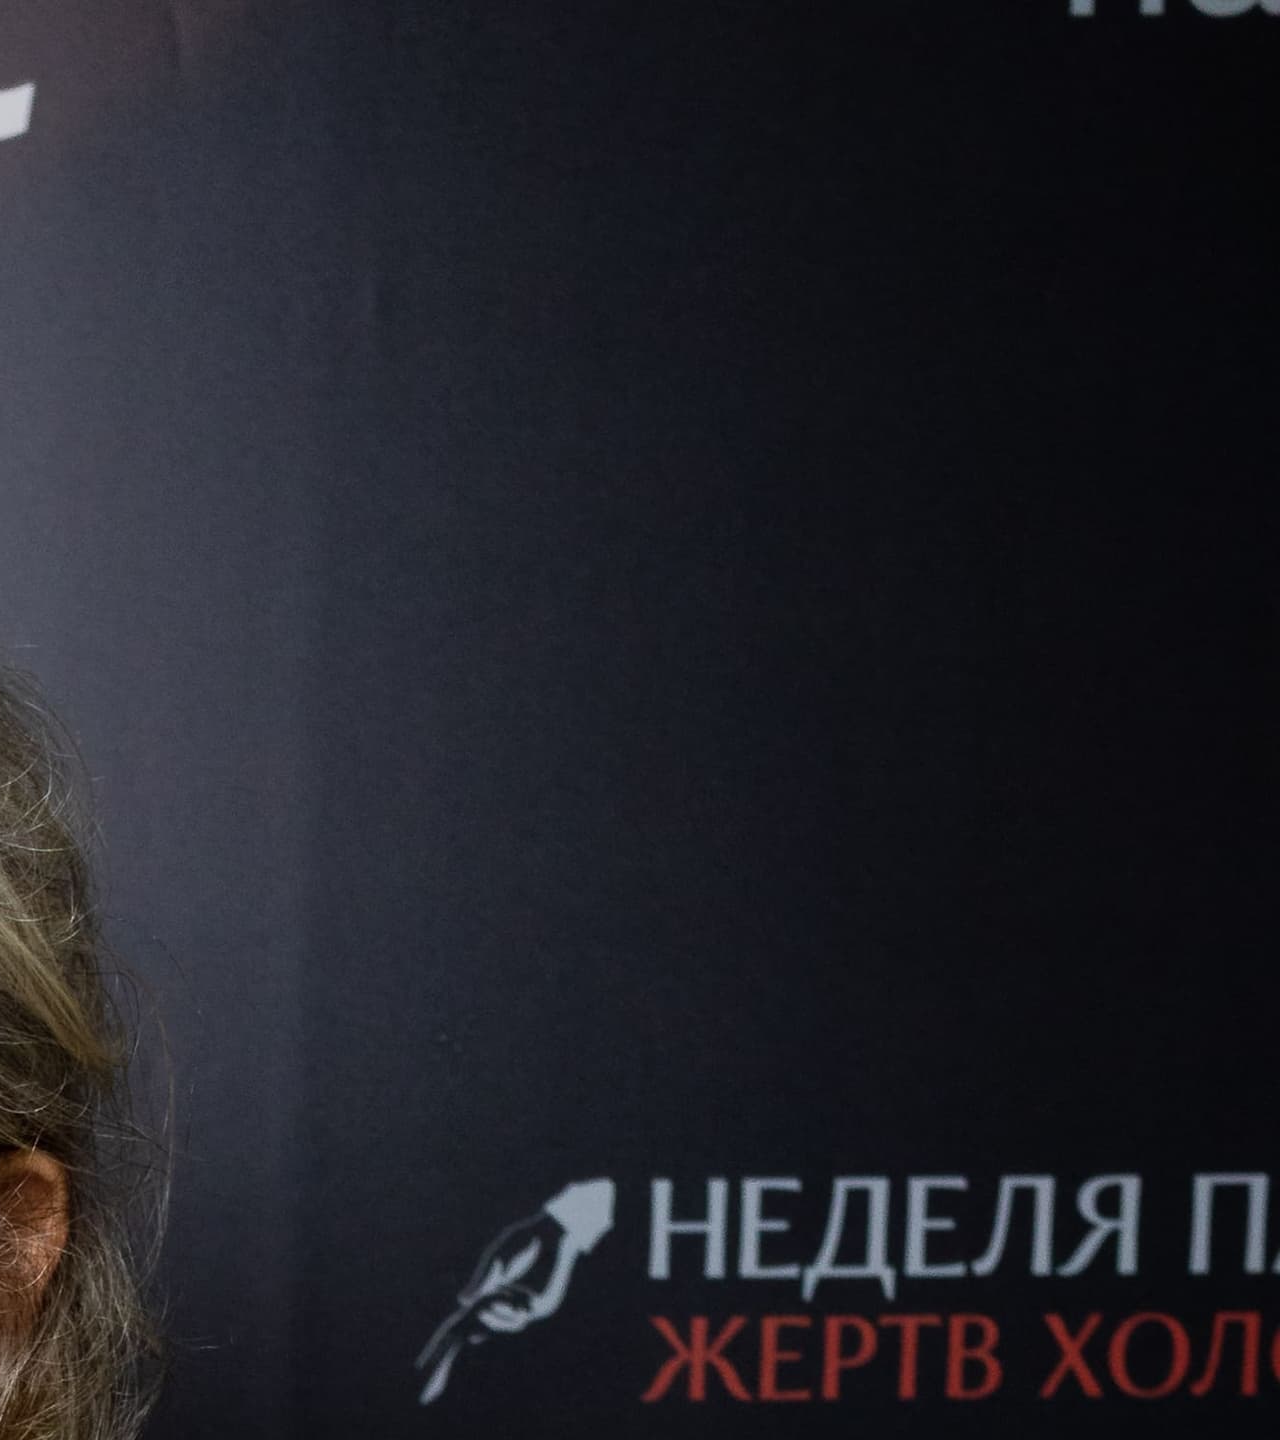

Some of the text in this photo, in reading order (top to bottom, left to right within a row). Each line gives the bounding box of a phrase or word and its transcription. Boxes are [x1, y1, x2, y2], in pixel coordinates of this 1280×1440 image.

[647, 1172, 1142, 1301] НЕДЕЛЯ
[641, 1309, 1280, 1402] ЖЕРТВ ХОЛ
